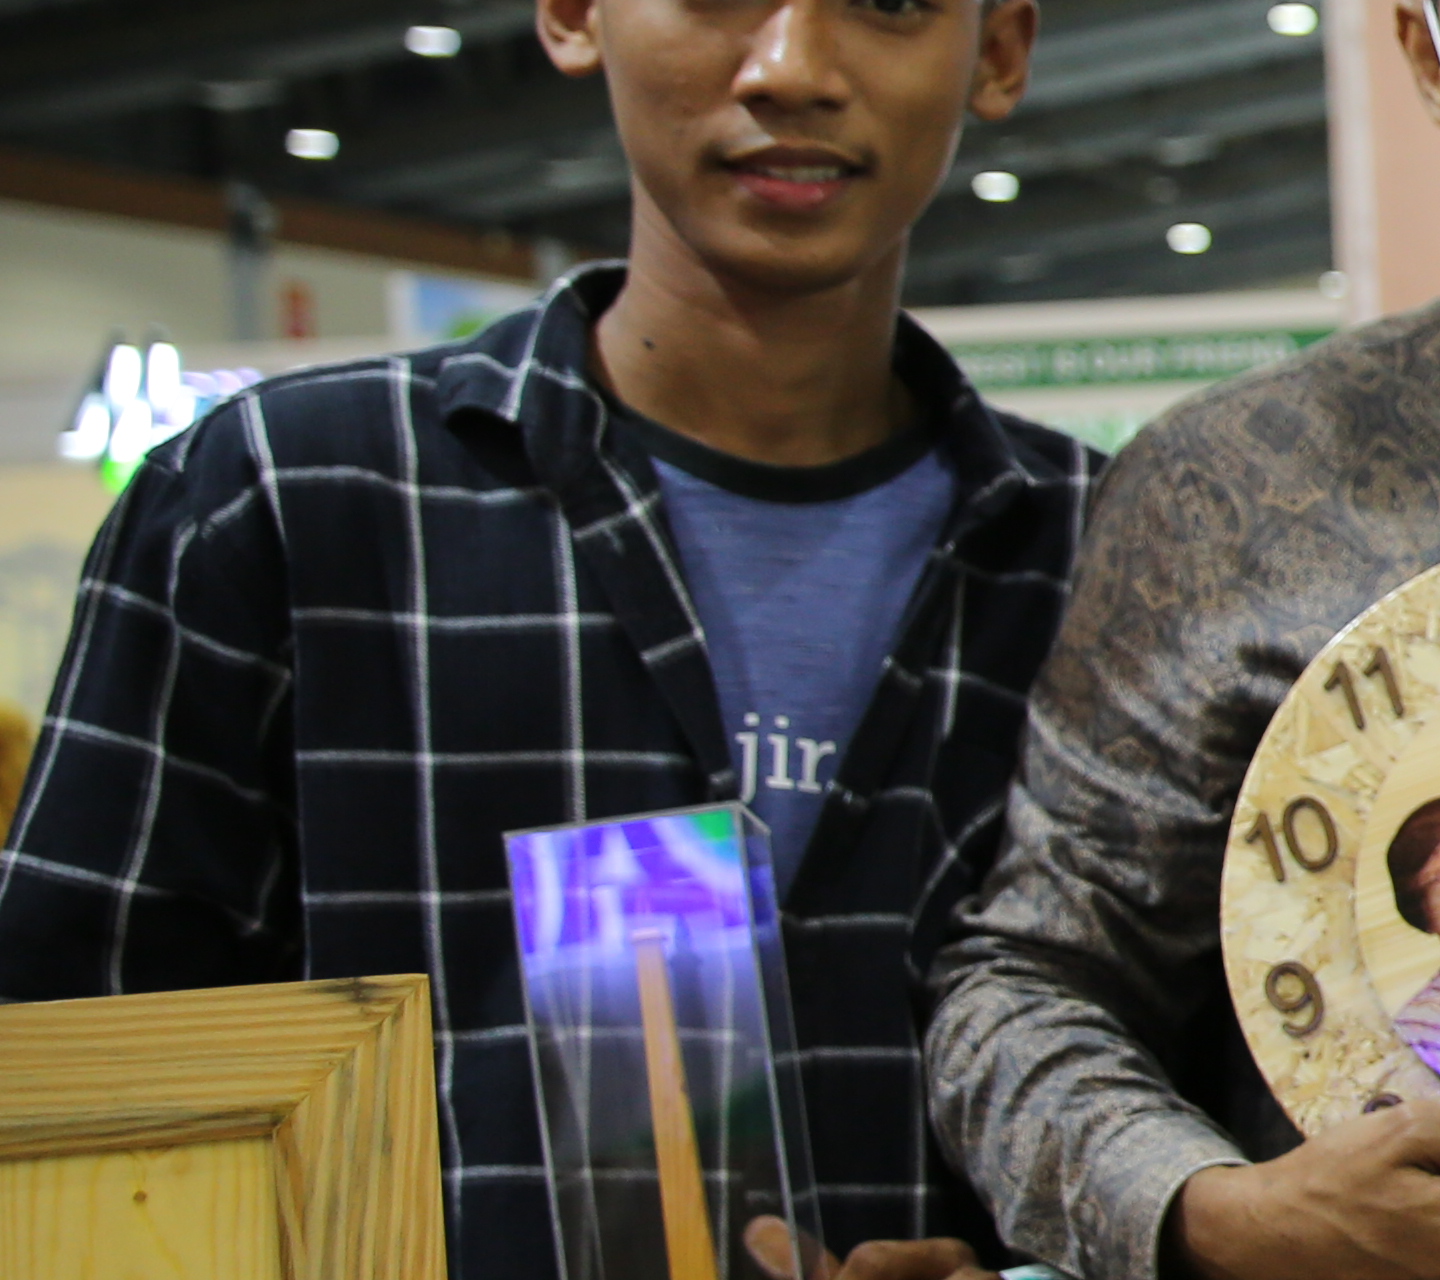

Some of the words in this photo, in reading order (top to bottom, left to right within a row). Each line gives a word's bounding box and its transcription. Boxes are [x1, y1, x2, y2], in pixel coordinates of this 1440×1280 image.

[1323, 645, 1405, 731] 11
[1245, 795, 1339, 884] 10
[1264, 960, 1325, 1040] 9
